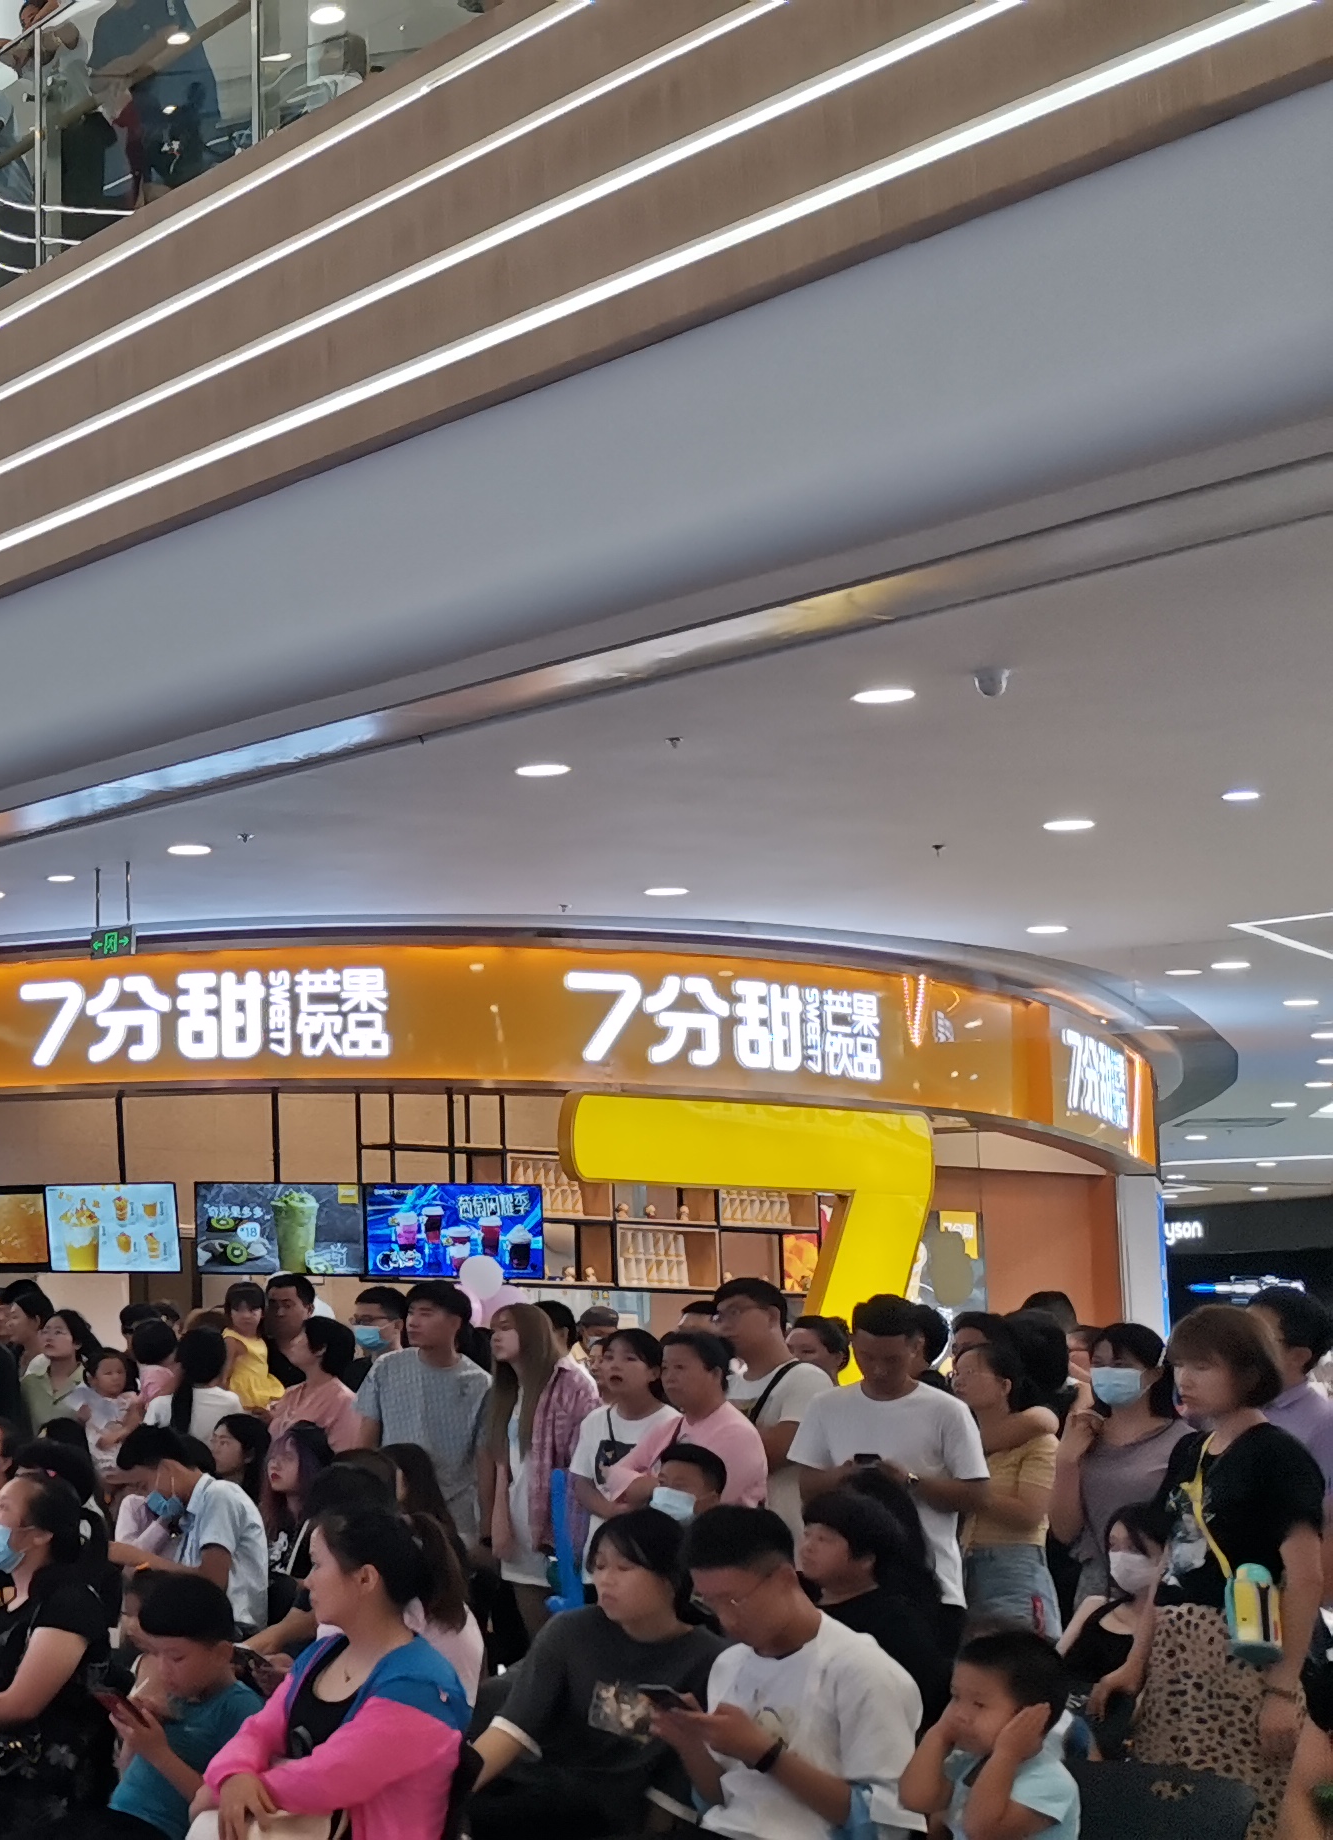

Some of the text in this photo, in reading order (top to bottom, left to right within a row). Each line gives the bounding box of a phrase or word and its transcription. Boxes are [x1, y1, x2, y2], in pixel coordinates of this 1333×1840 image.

[20, 970, 267, 1067] 7分甜
[564, 972, 802, 1072] 7分甜
[1164, 1221, 1204, 1246] yson
